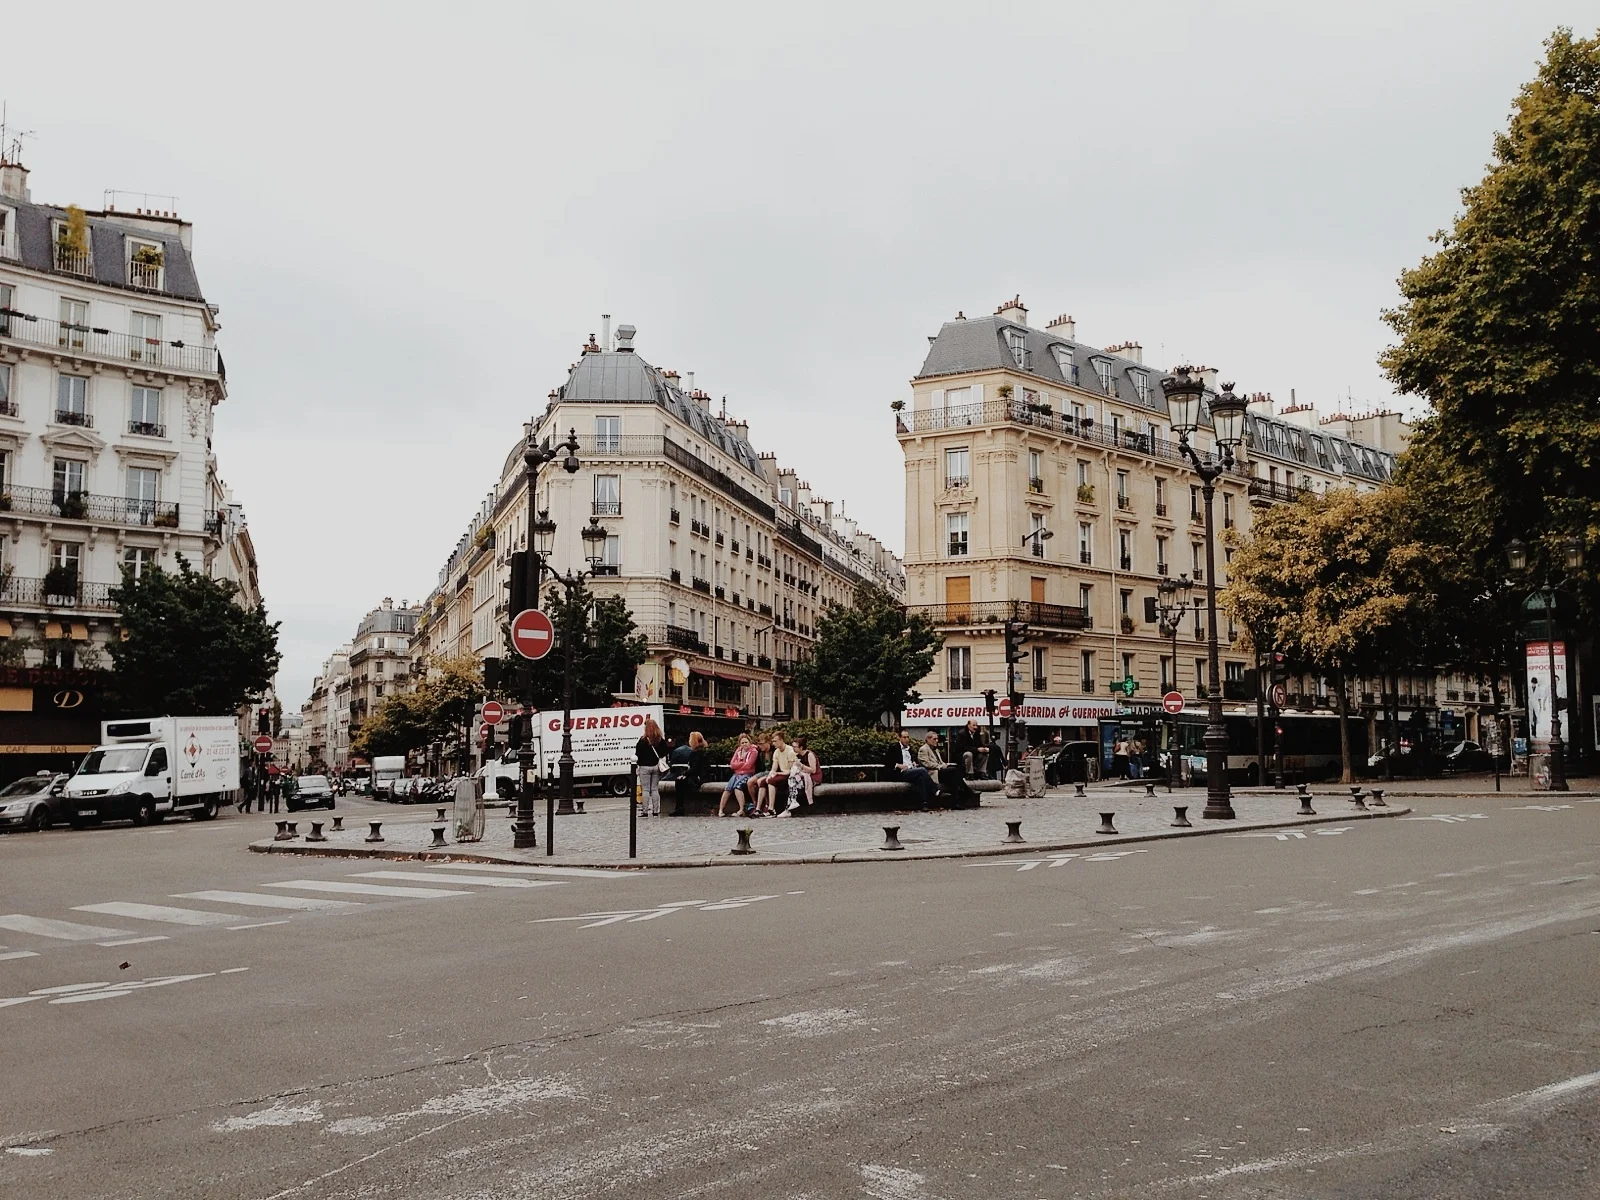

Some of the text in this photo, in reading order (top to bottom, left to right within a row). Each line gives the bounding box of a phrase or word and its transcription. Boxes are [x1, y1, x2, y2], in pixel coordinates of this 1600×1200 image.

[53, 689, 84, 708] D
[906, 708, 942, 718] ESPACE
[946, 706, 1000, 717] GUERRIO
[1014, 705, 1056, 718] GUERRIDA
[50, 745, 68, 753] BAR
